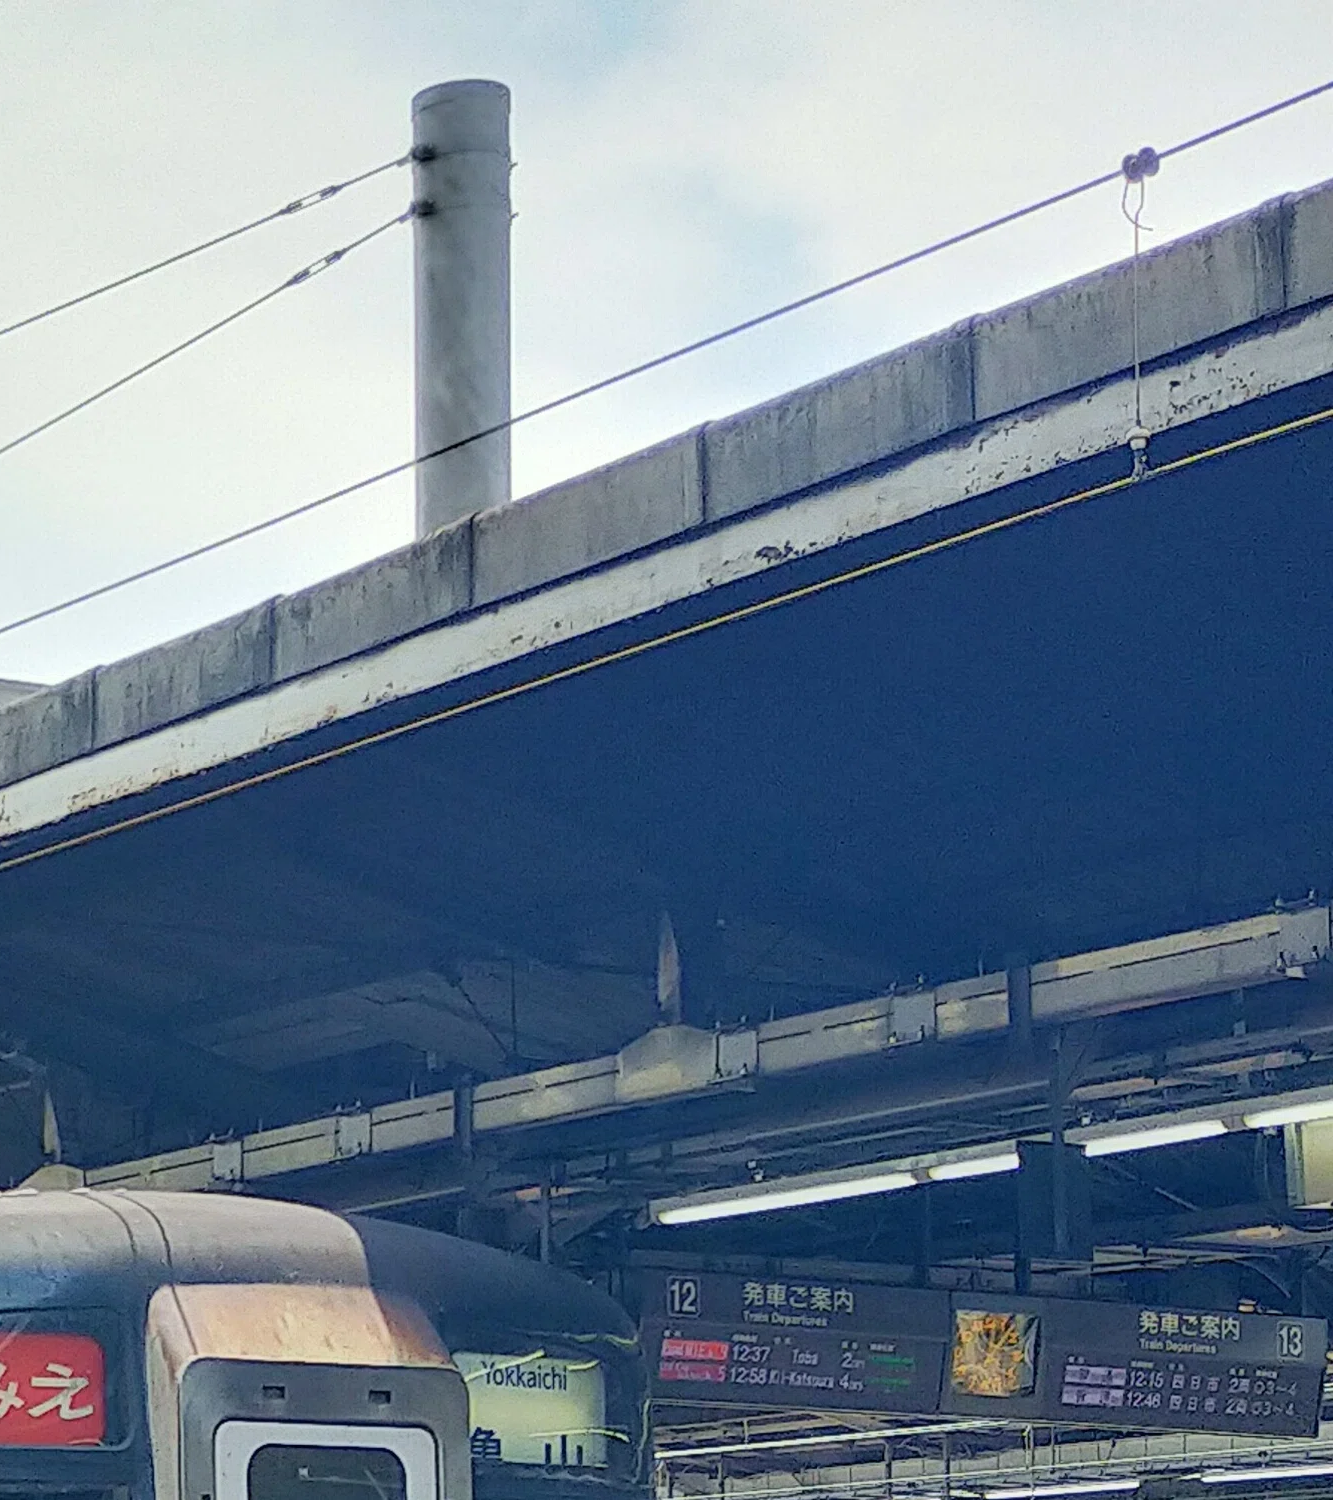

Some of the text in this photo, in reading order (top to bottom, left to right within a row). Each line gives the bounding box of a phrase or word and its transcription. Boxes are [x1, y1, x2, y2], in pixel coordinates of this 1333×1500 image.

[669, 1280, 697, 1313] 12
[742, 1281, 854, 1314] 発車ご案内
[1139, 1311, 1241, 1341] 発車ご案内
[1278, 1325, 1302, 1357] 13
[731, 1345, 771, 1363] 12:37
[481, 1360, 568, 1392] Yokkaichi
[729, 1367, 767, 1386] 12:58
